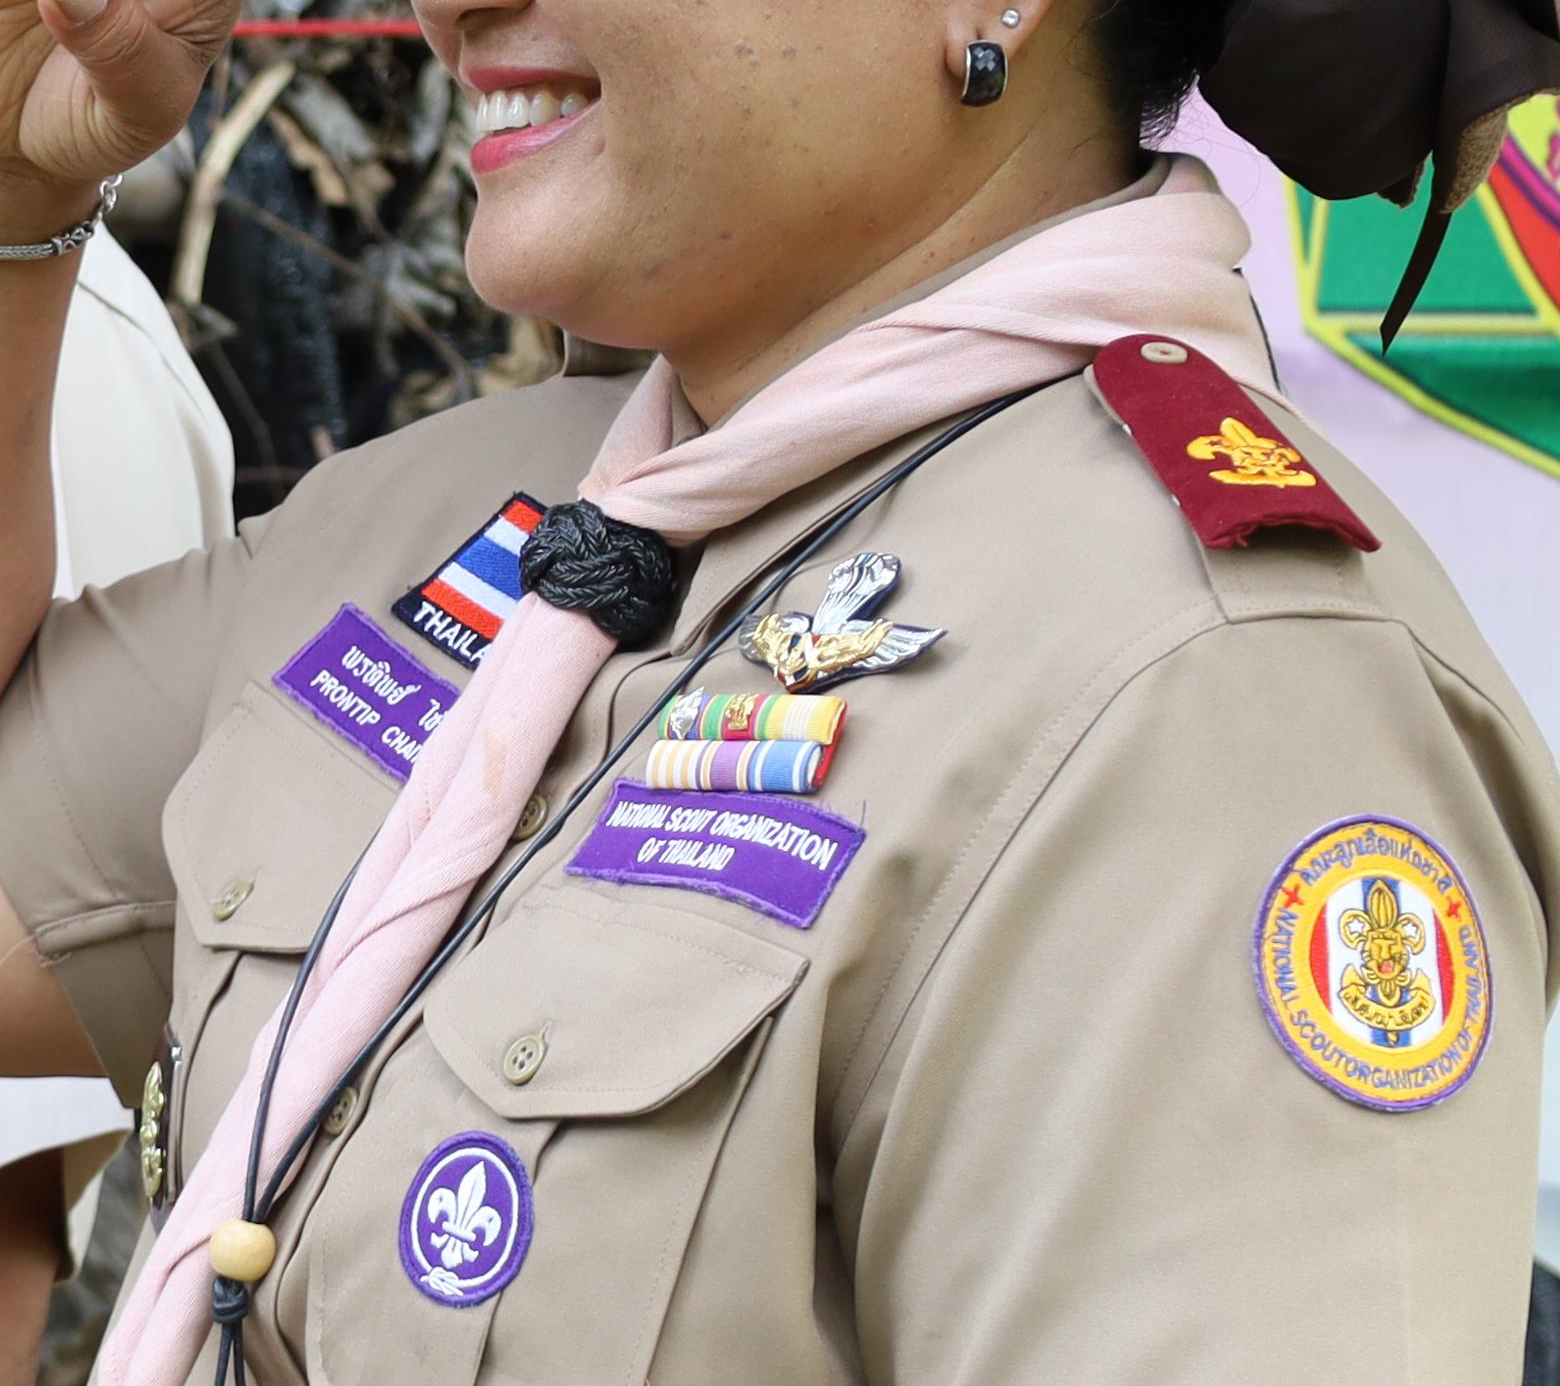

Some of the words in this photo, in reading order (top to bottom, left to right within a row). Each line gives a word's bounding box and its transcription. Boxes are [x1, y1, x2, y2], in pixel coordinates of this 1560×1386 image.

[310, 669, 381, 725] PRONTIP
[606, 801, 672, 828] NATIONAL
[666, 807, 717, 833] SCOUT
[710, 811, 839, 870] ORGANIZATION
[637, 838, 665, 863] OF
[660, 839, 735, 870] THAILAND
[1271, 907, 1301, 1009] NATIONAL
[1290, 1007, 1348, 1071] SCOUT
[1344, 1047, 1466, 1090] ORGANIZATION
